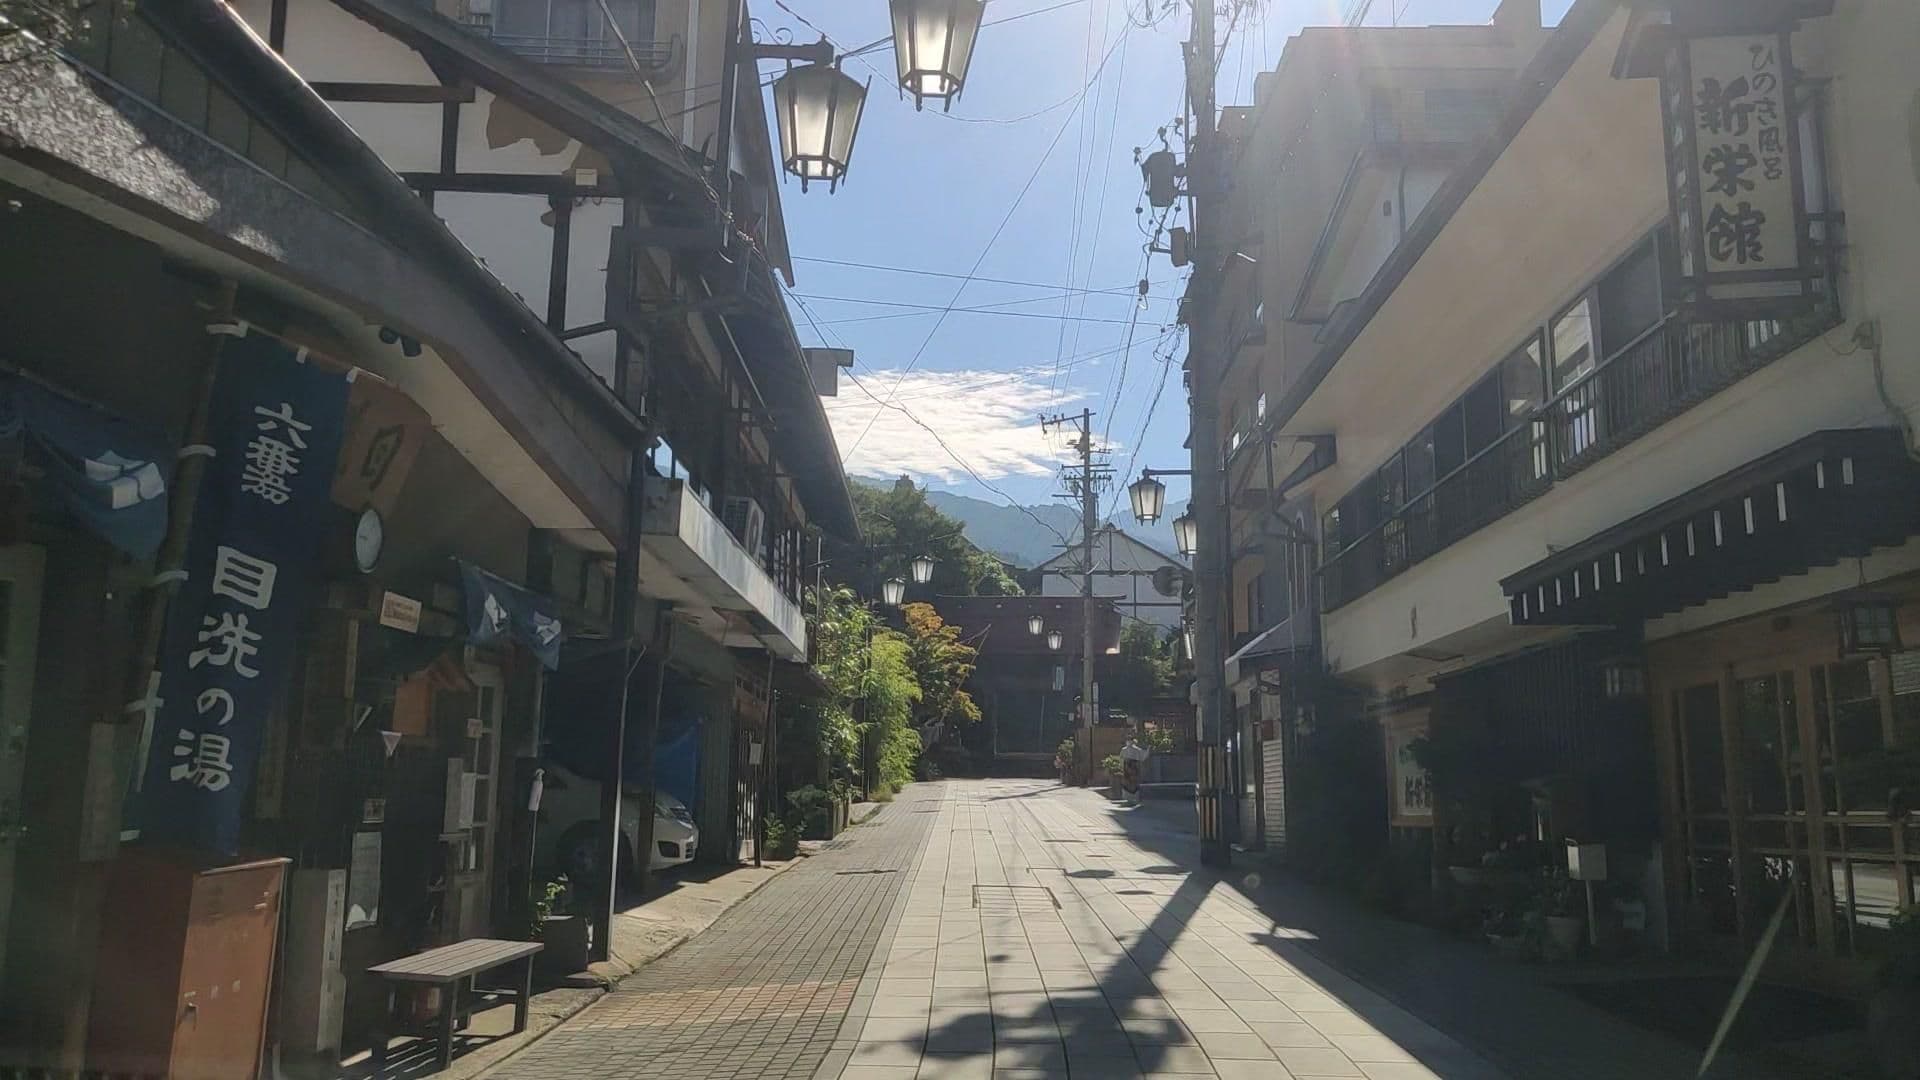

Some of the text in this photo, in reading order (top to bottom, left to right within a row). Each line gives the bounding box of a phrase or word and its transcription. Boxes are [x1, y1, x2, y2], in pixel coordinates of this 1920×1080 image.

[1695, 75, 1766, 265] 新栄館
[1748, 44, 1785, 181] ひのき風呂
[169, 545, 278, 792] 目洗の湯
